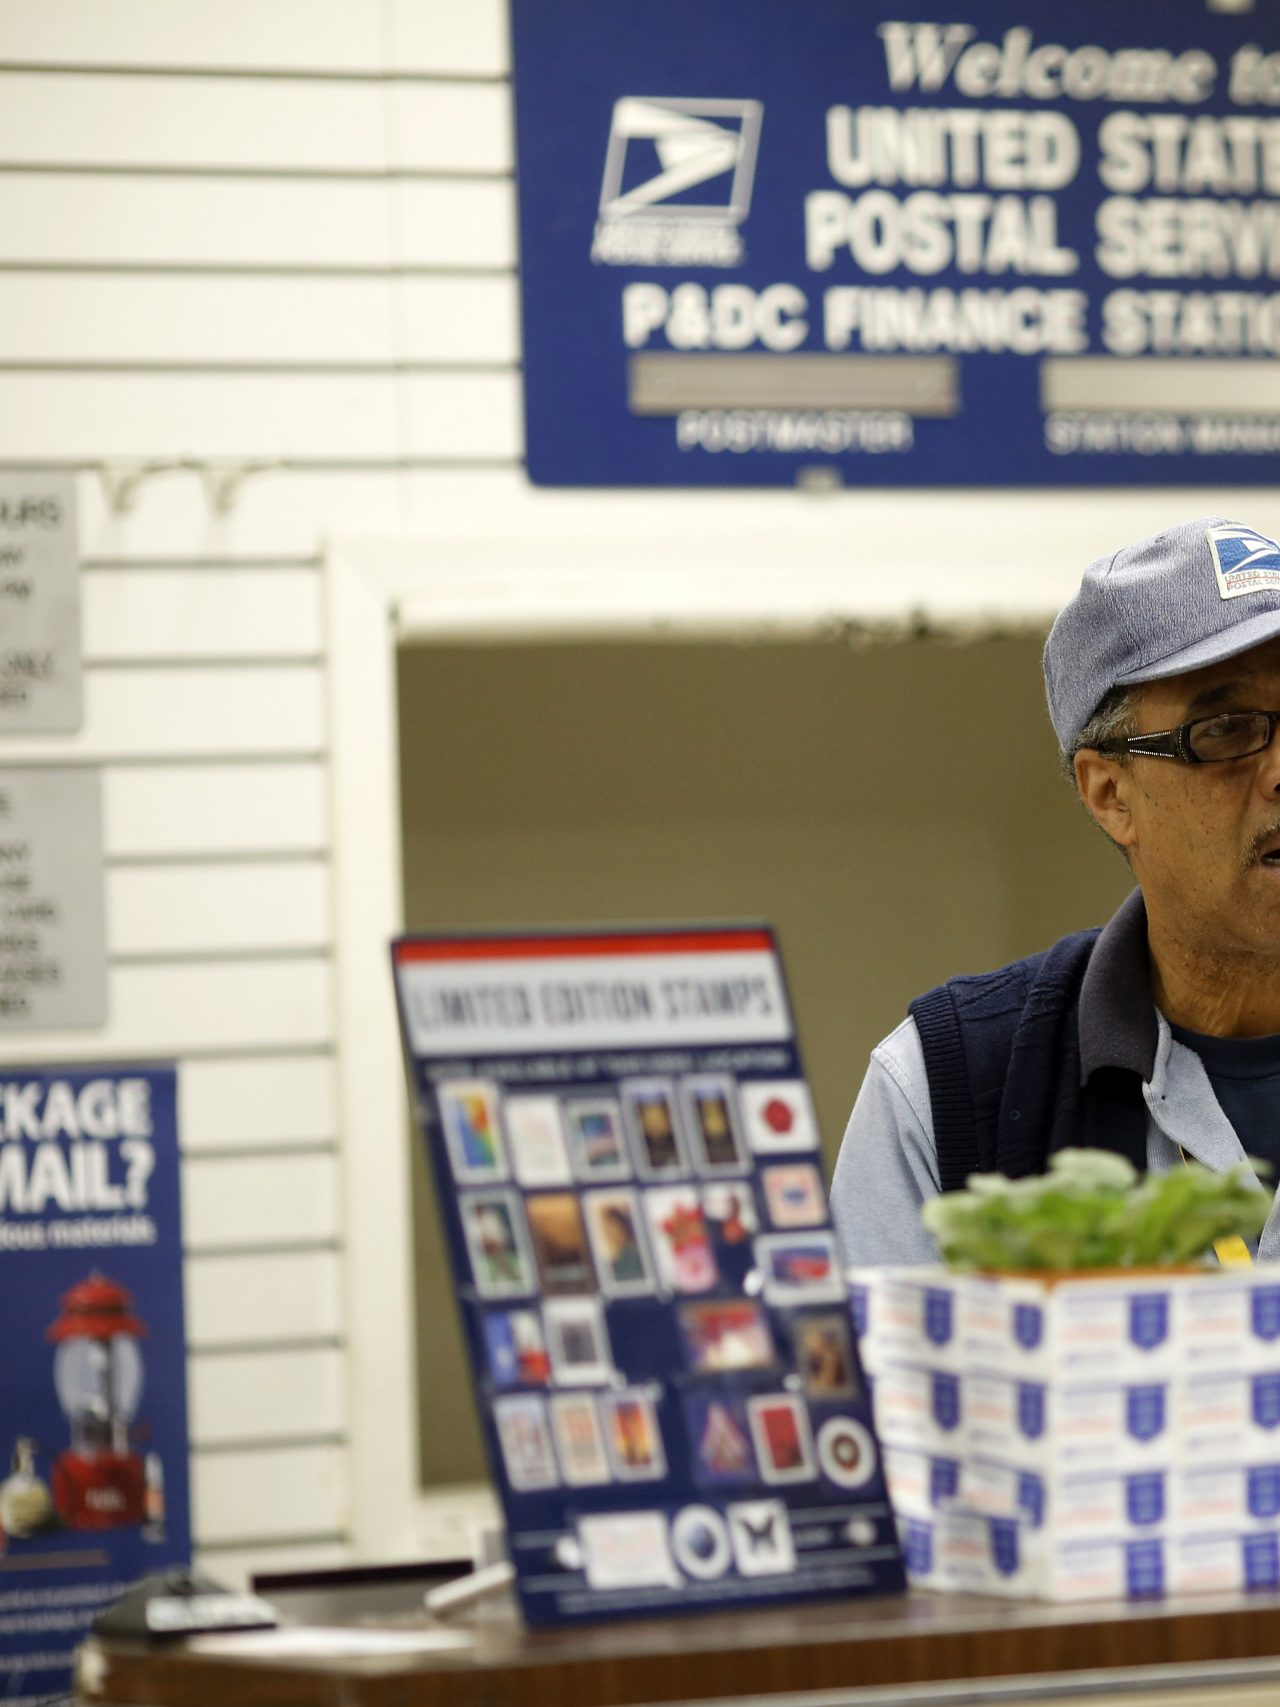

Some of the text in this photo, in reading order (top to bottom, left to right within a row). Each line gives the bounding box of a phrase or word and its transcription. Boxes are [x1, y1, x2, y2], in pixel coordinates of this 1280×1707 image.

[877, 22, 1217, 103] Welcome
[826, 104, 1080, 190] UNITED
[805, 189, 1080, 276] POSTAL
[622, 282, 808, 352] P&DC
[823, 285, 1089, 355] FINANCE
[676, 410, 915, 455] POSTMASTER
[1044, 412, 1184, 456] STATION
[1224, 570, 1260, 583] UNITED
[1227, 579, 1262, 591] POSTAL
[412, 972, 773, 1031] LIMITED EDITION STAMPS
[0, 1077, 154, 1142] KAGE
